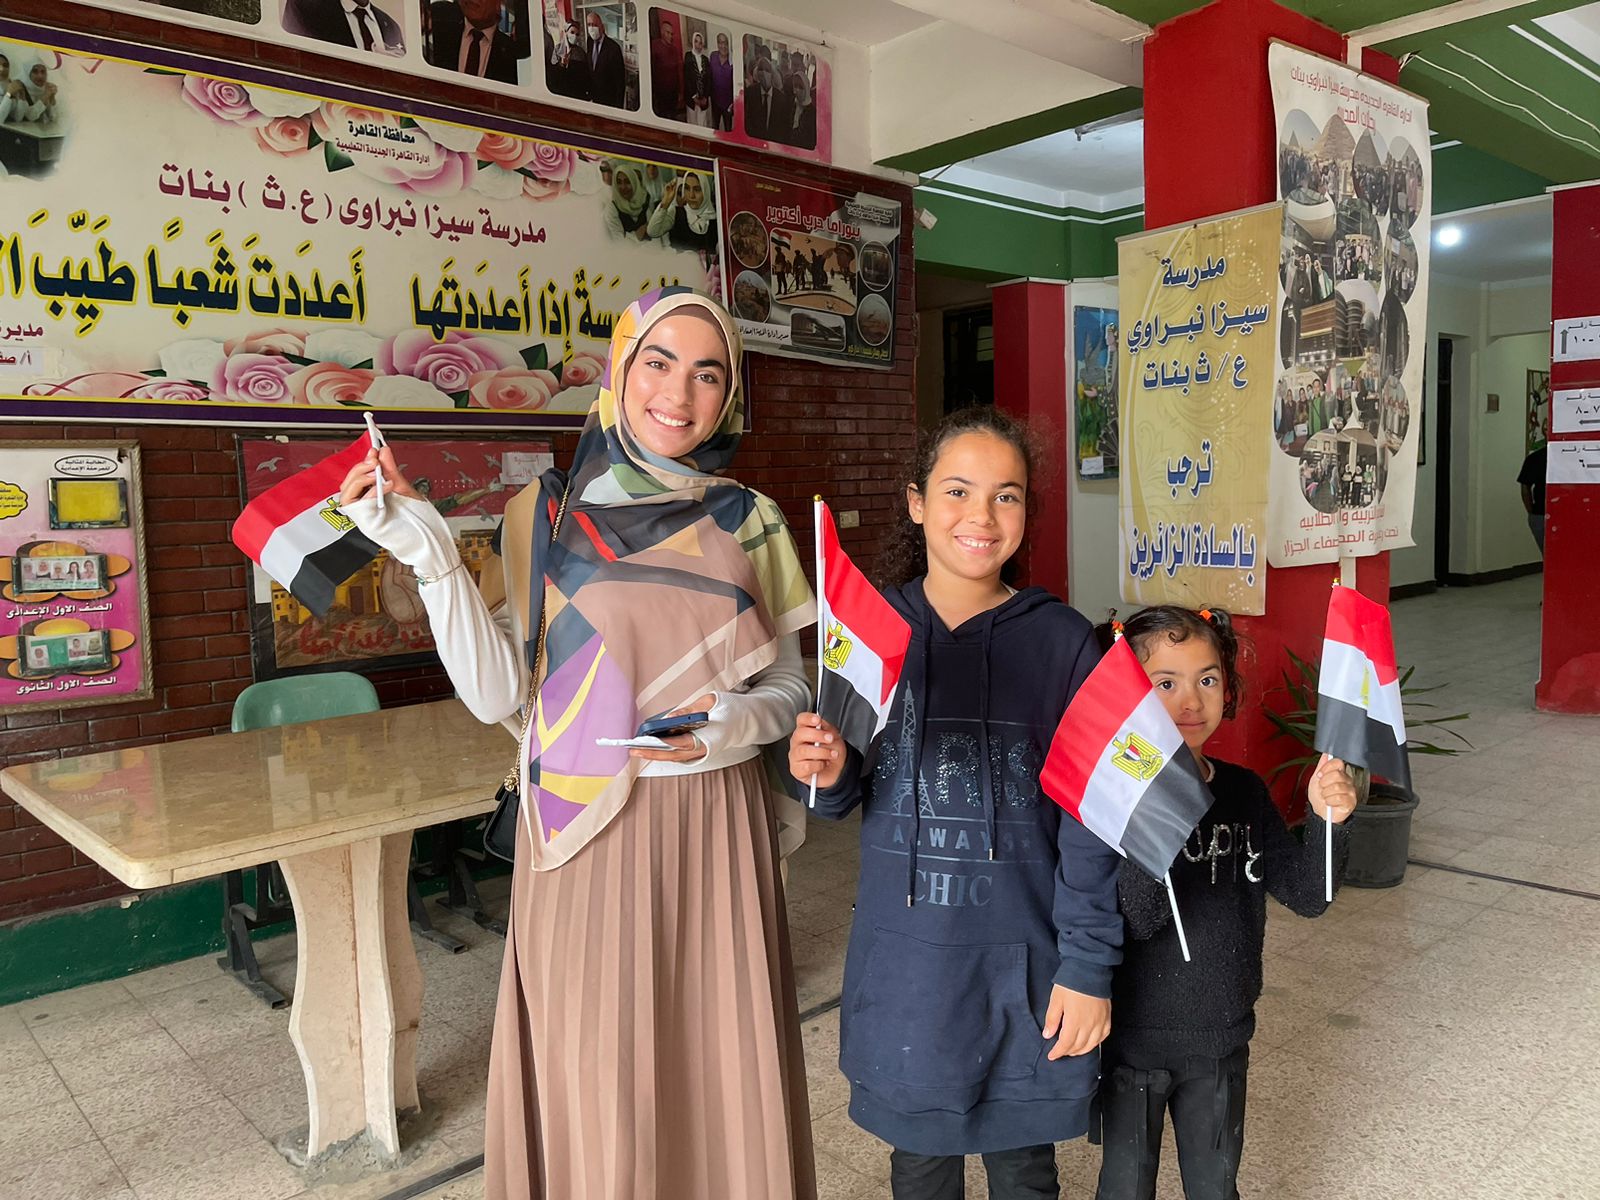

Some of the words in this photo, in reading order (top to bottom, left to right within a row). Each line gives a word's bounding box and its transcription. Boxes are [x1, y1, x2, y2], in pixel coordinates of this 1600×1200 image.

[348, 121, 382, 138] القاهرة
[384, 125, 416, 144] محافظة
[335, 137, 366, 153] التعليمية
[366, 144, 391, 158] الجديدة
[391, 148, 416, 161] القاهرة
[158, 163, 232, 214] بنات
[425, 202, 475, 243] سيزا
[766, 205, 802, 225] أكتوبر
[802, 215, 824, 231] حرب
[480, 208, 547, 248] مدرسة
[827, 215, 862, 241] بنوراما
[1160, 254, 1227, 290] مدرسة
[1126, 302, 1206, 355] نبراوي
[1210, 299, 1270, 338] سيزا
[1142, 354, 1191, 396] بنات
[1166, 438, 1214, 501] ترحب
[1129, 522, 1192, 580] الزائرين
[1193, 522, 1257, 588] بالسادة
[1284, 538, 1310, 558] الجزار
[52, 604, 76, 616] الاول
[79, 602, 113, 612] الصف
[56, 679, 80, 691] الاول
[83, 676, 117, 686] الصف
[913, 868, 994, 908] CHIC
